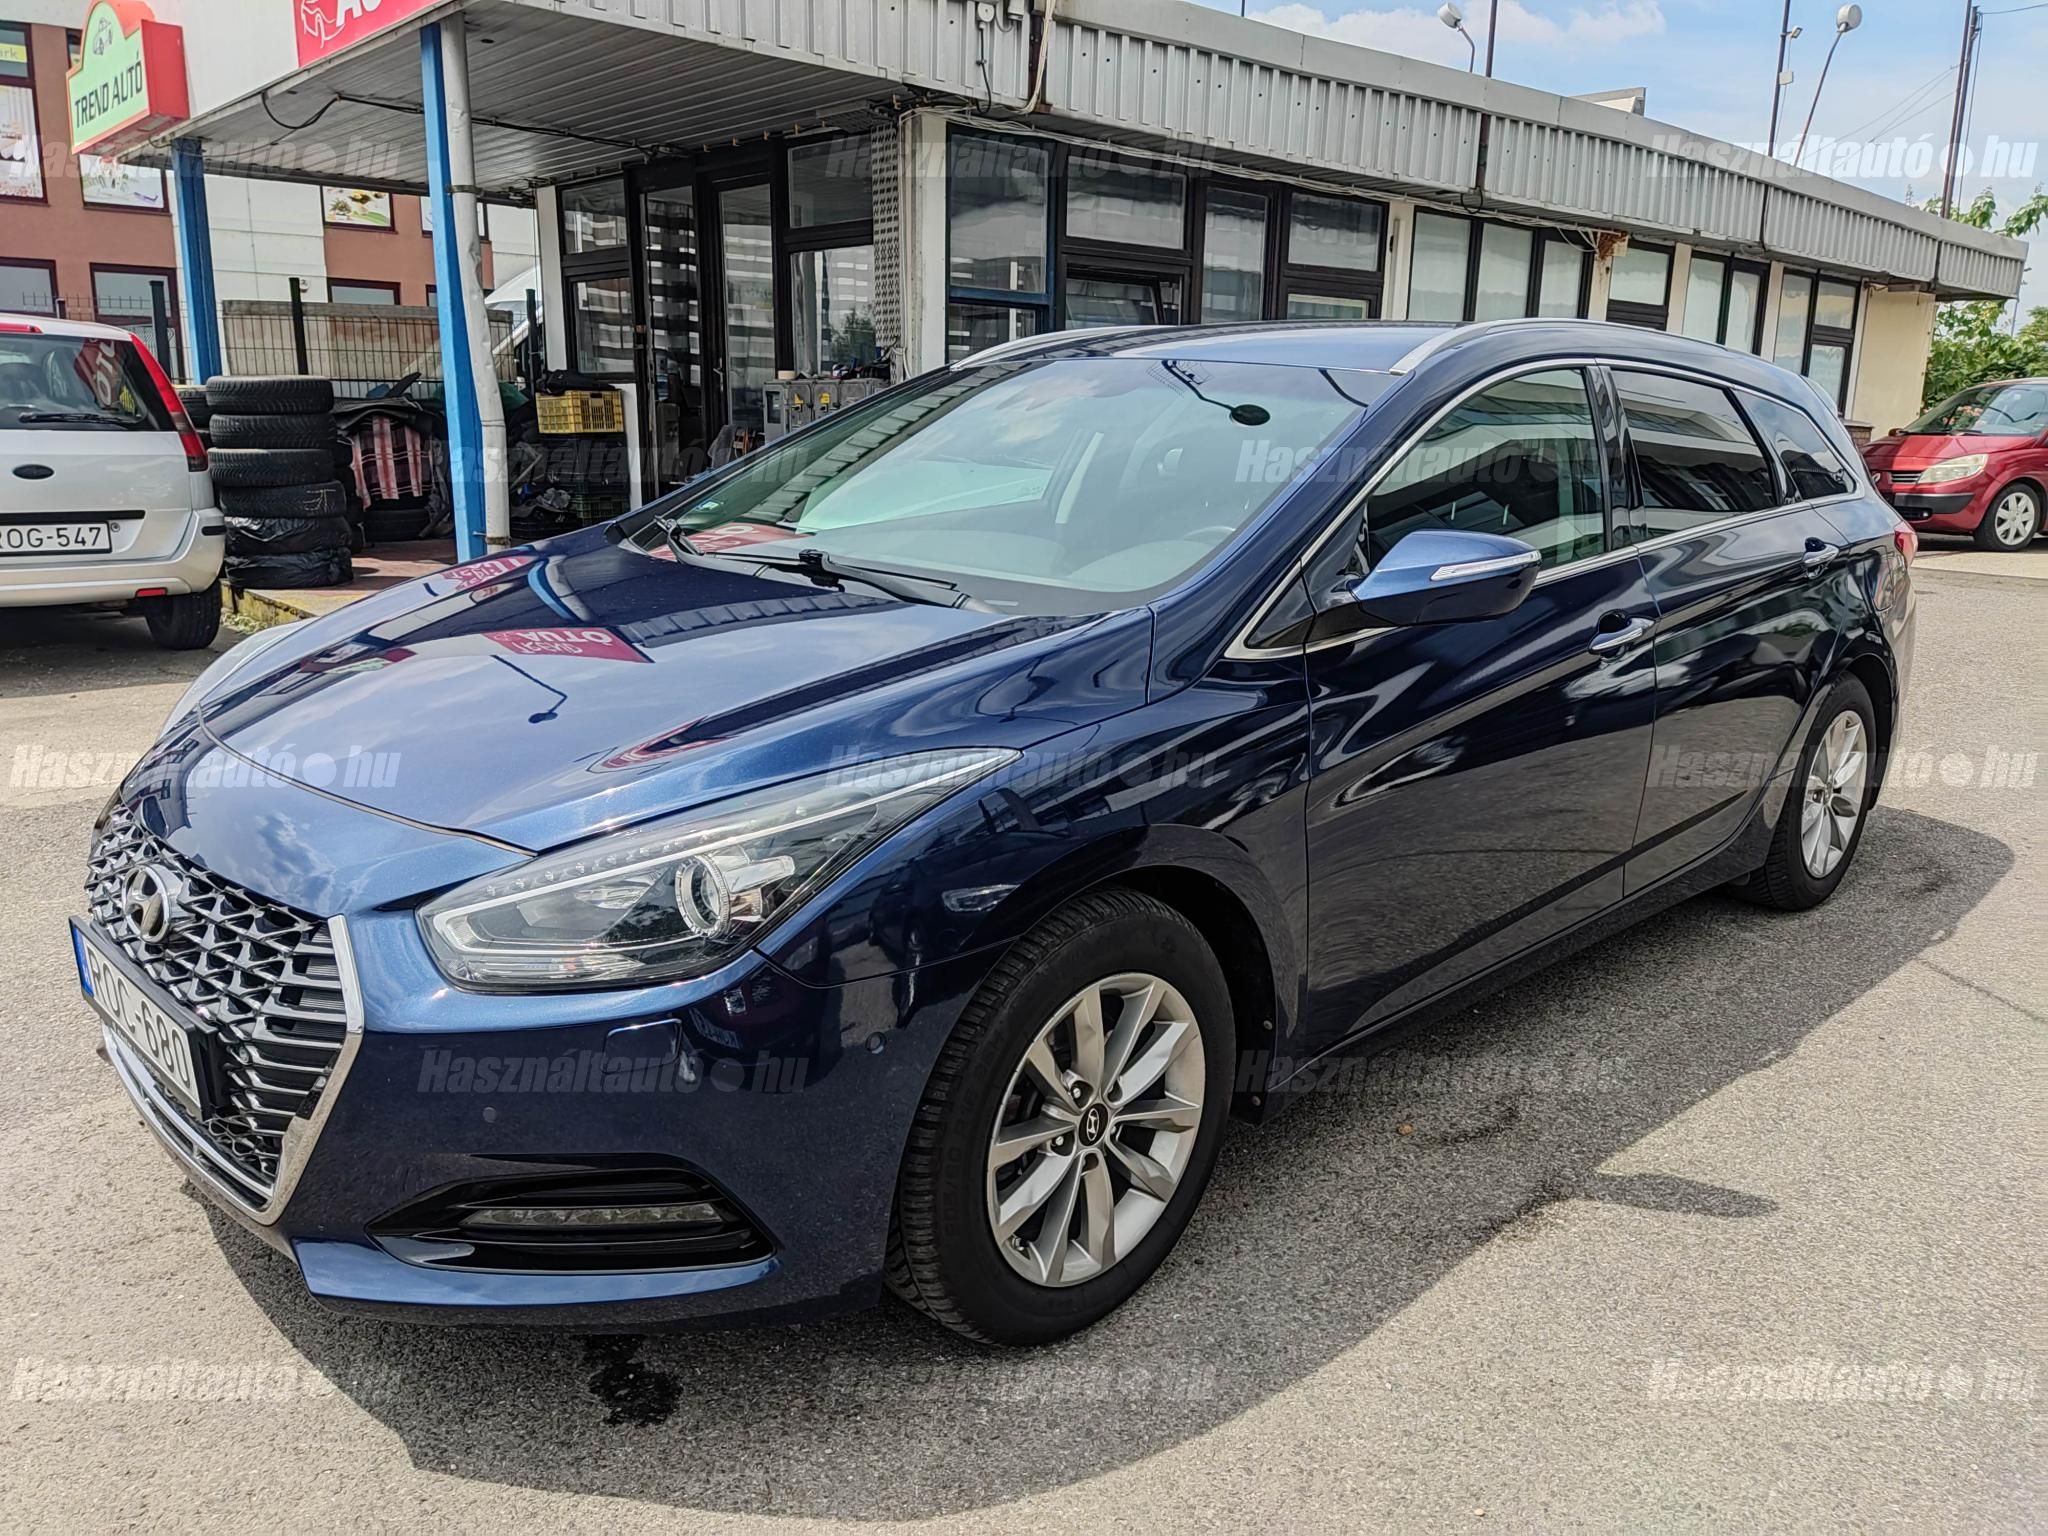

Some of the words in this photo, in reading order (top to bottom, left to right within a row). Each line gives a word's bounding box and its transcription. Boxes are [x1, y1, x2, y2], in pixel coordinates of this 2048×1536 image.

[75, 82, 110, 128] TREND
[111, 50, 143, 110] AUTÓ
[88, 947, 191, 1089] ROC-680
